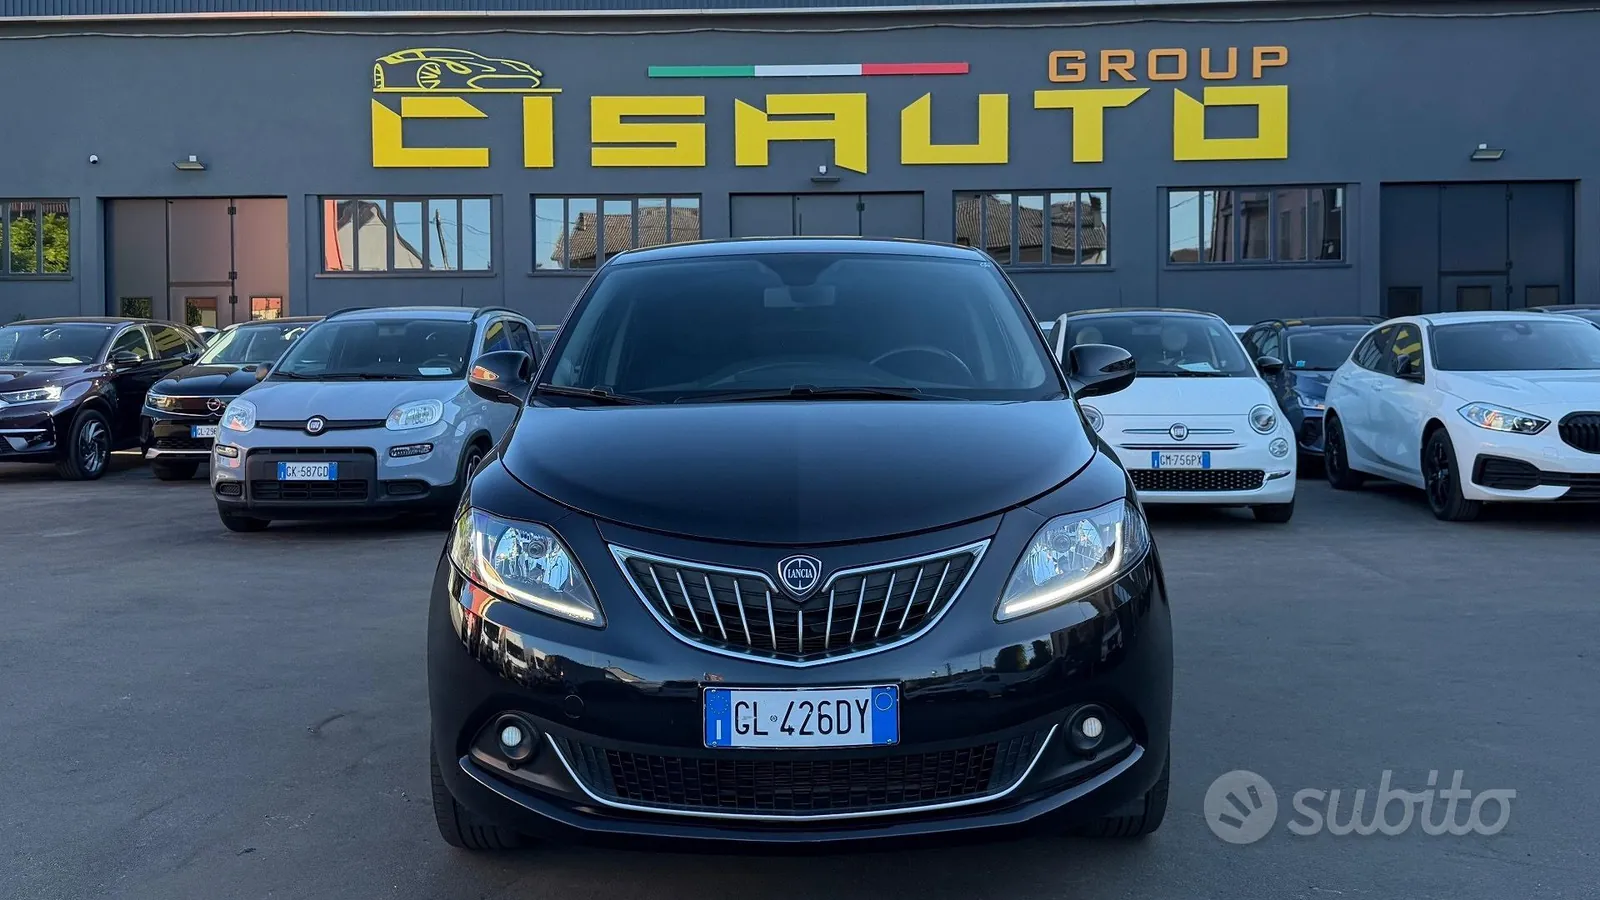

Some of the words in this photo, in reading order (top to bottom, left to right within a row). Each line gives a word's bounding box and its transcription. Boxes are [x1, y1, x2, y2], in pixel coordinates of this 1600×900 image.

[1048, 46, 1289, 82] GROUP
[371, 85, 1289, 174] CISAUTO
[787, 568, 813, 579] LANCIA
